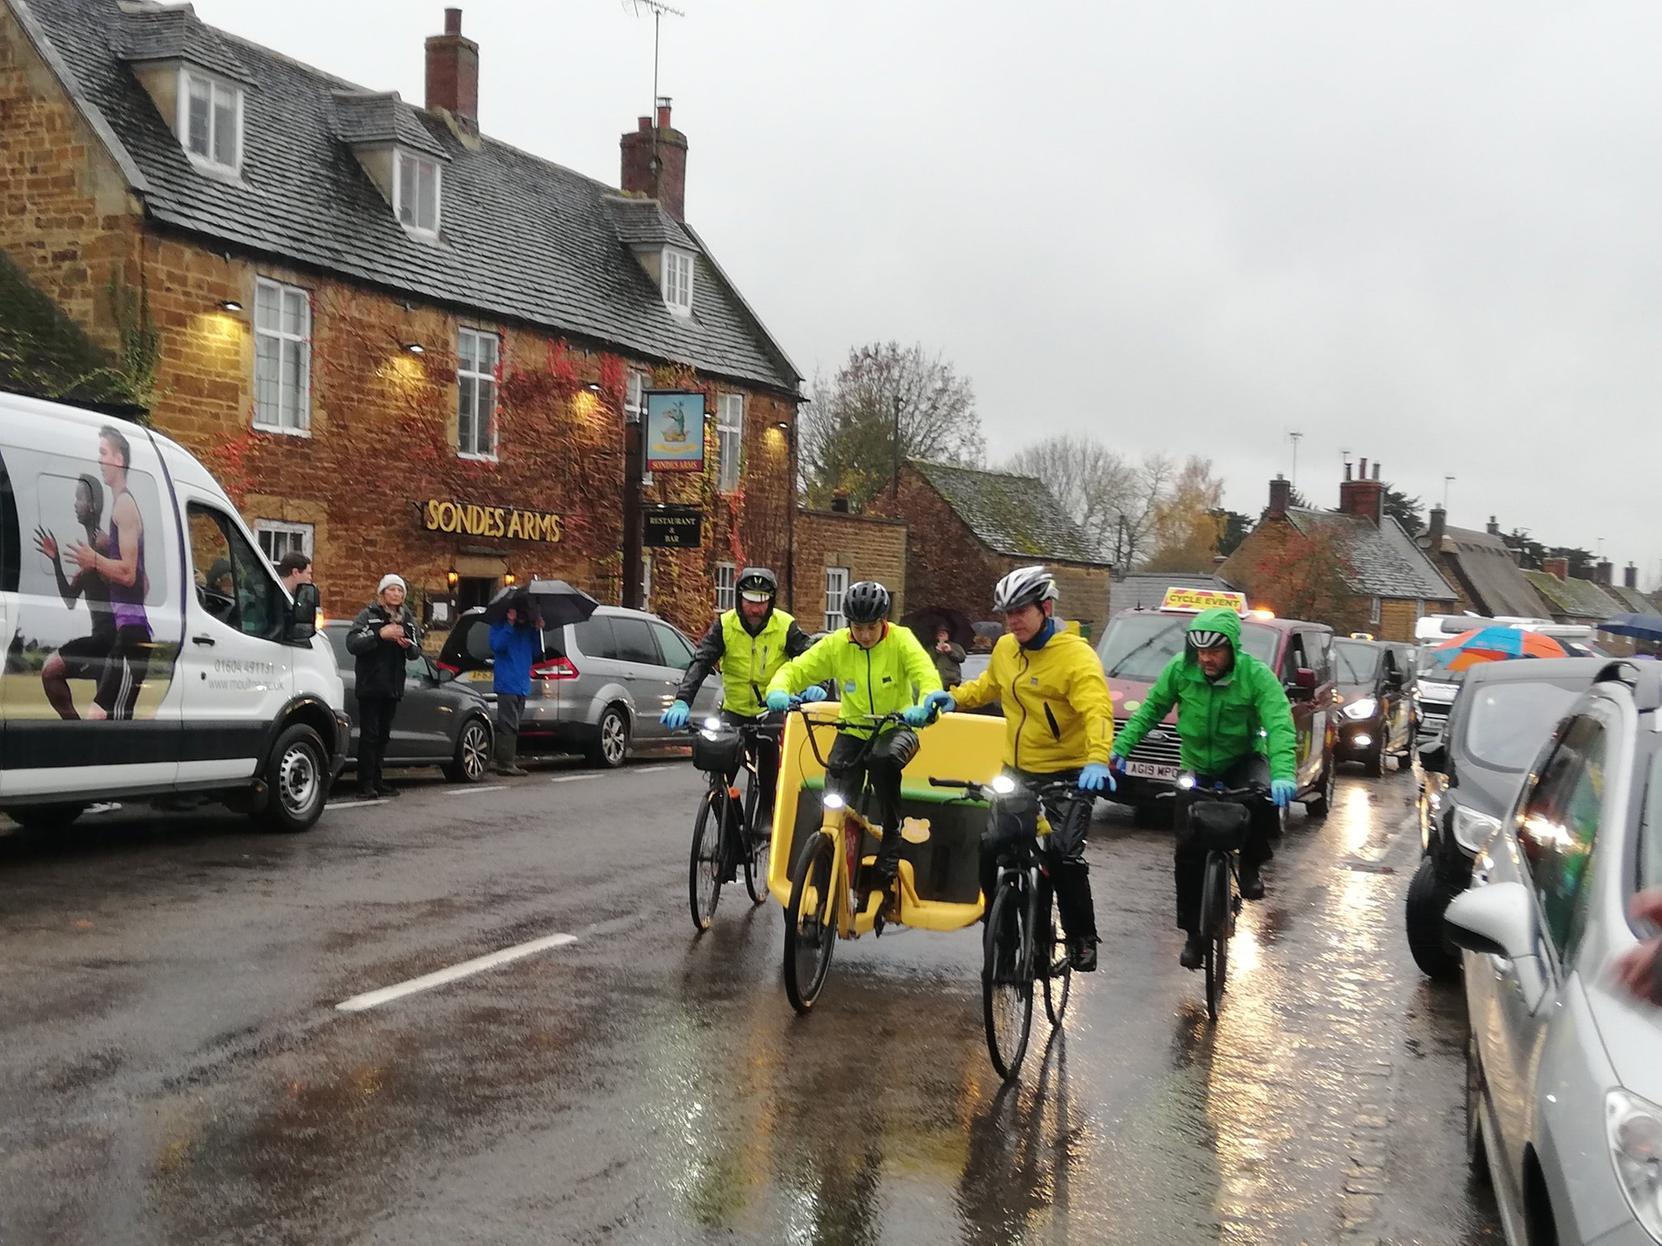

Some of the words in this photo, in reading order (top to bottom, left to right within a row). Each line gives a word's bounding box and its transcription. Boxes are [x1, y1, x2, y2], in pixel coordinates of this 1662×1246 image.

[426, 500, 505, 538] SONDES
[507, 510, 561, 543] ARMS
[649, 517, 696, 526] RESTAURANT
[664, 535, 680, 543] BAR
[1169, 594, 1201, 605] CYCLE
[1205, 597, 1240, 607] EVENT
[214, 659, 241, 673] 01604
